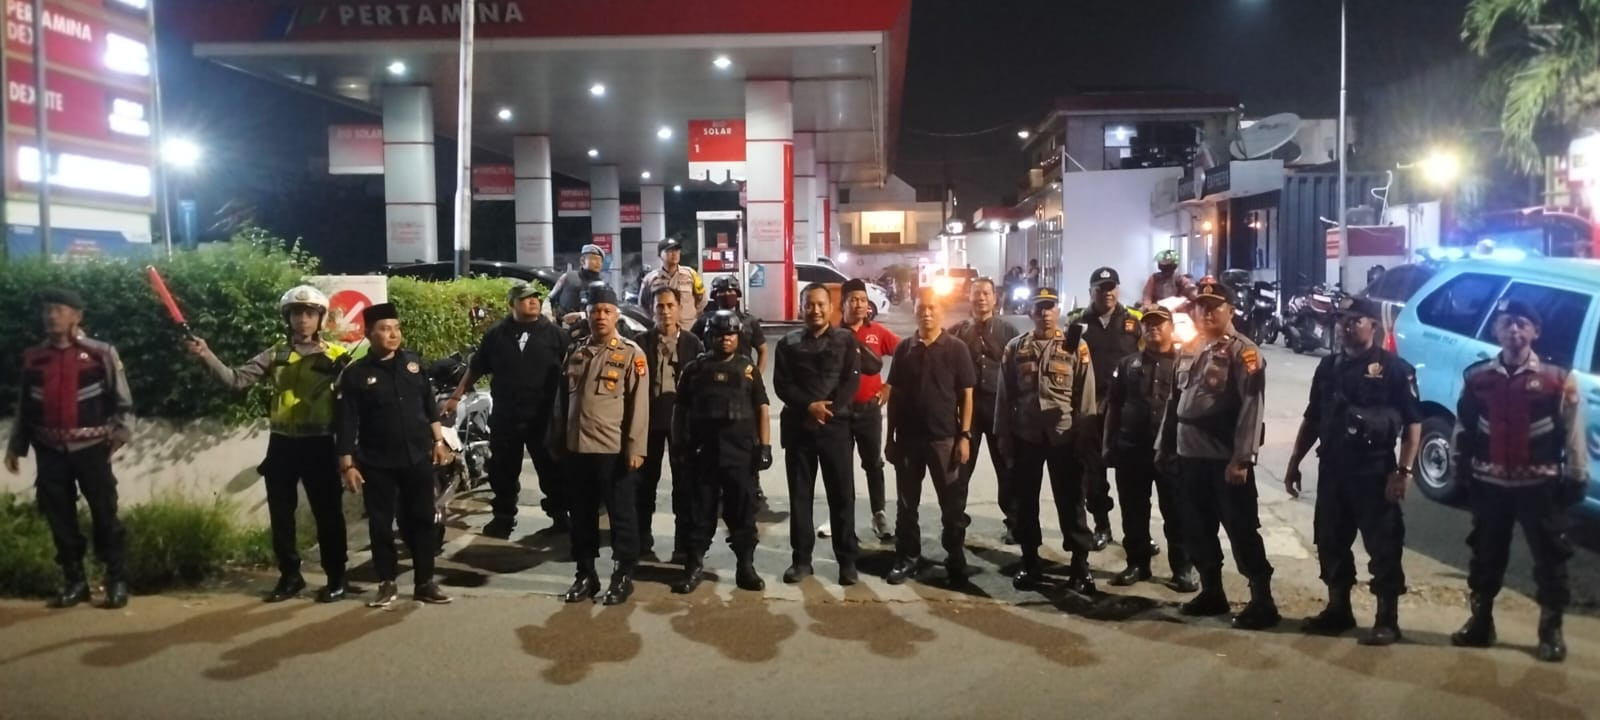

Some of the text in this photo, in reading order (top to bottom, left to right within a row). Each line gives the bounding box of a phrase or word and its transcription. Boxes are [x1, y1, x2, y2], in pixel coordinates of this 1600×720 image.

[6, 0, 92, 42] PERAMINA
[339, 3, 525, 25] PERTAMNA
[9, 81, 64, 112] DEXITE
[703, 127, 732, 136] SOLAR
